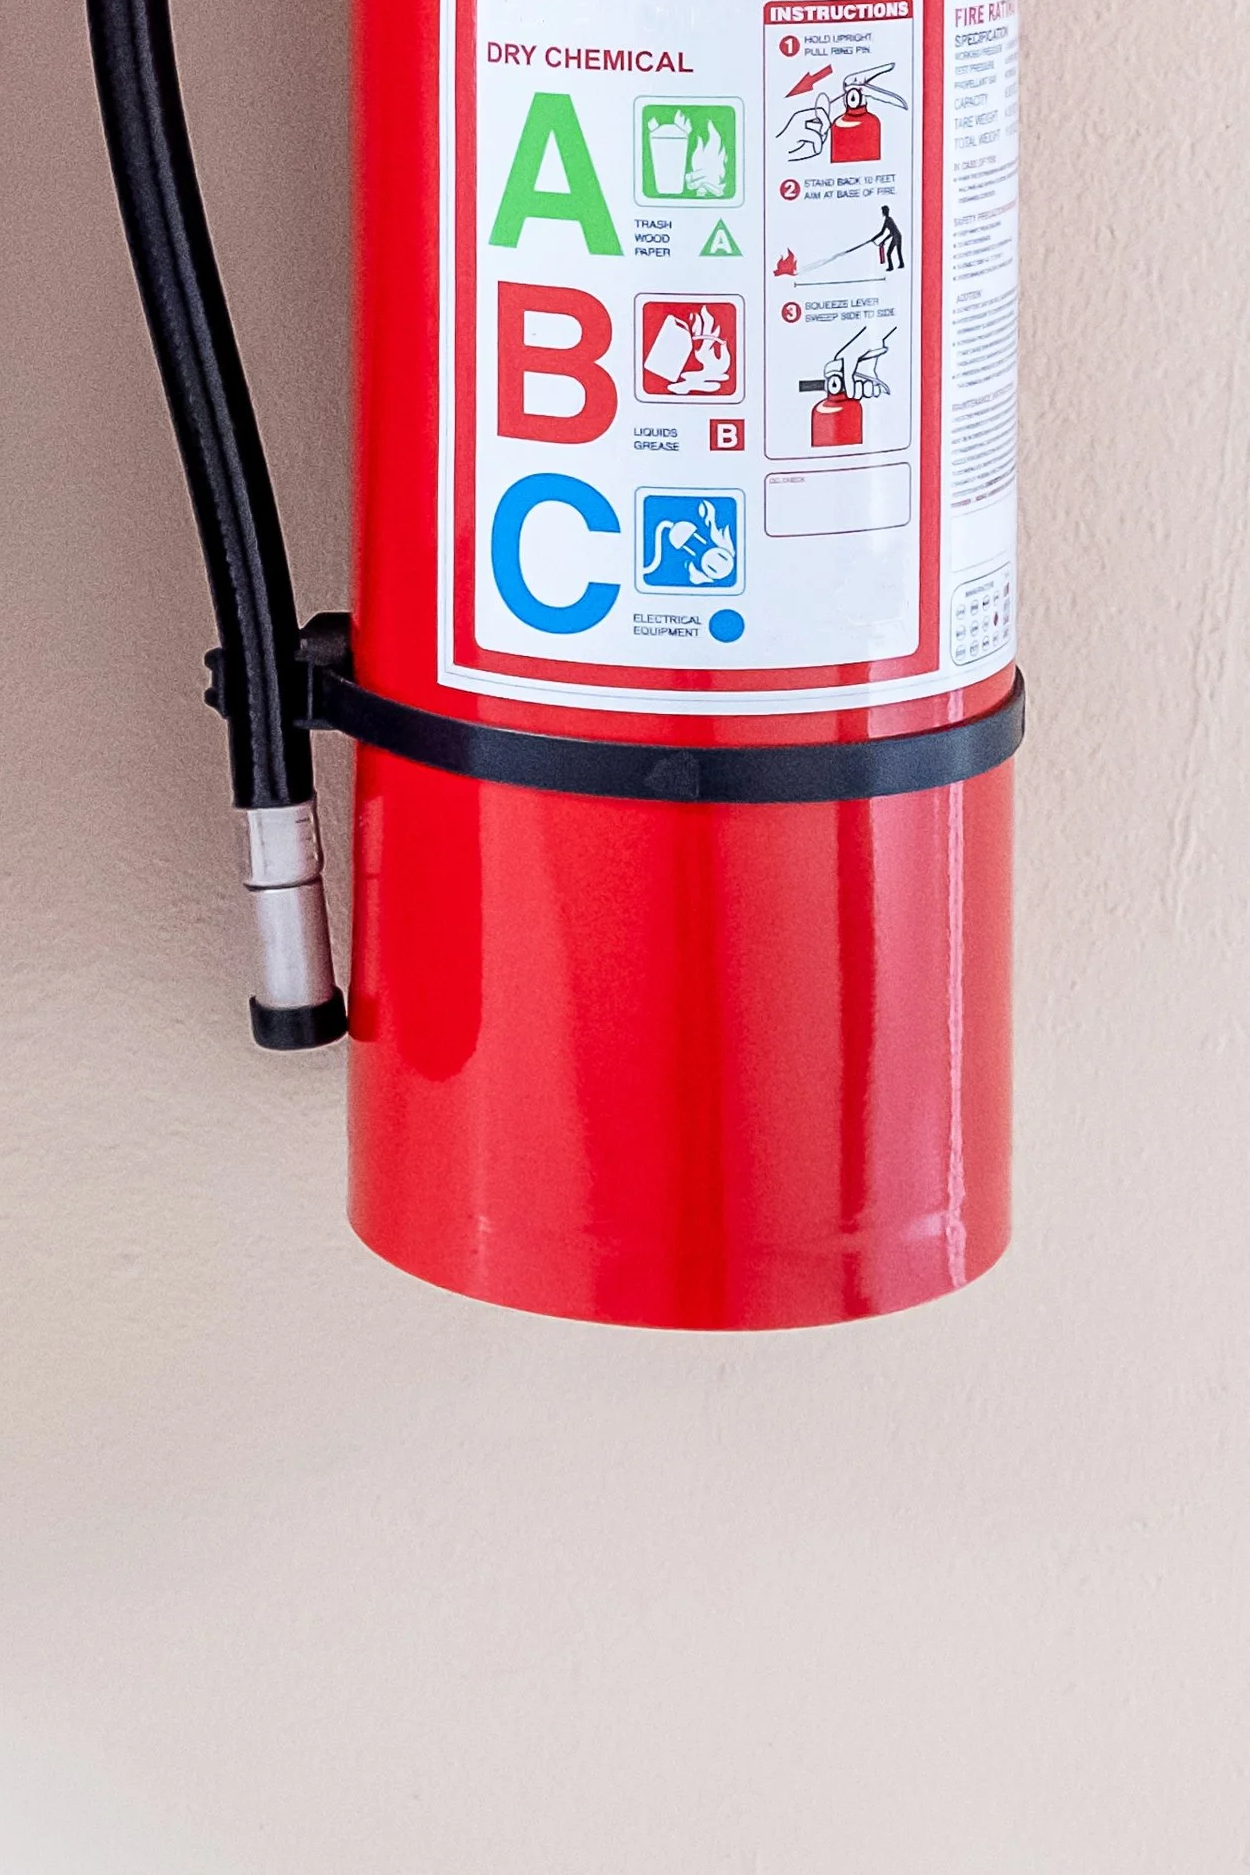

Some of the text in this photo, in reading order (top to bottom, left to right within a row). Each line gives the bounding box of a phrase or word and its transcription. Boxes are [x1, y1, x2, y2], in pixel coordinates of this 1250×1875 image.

[770, 1, 908, 22] INSTRUCTIONS
[955, 4, 985, 28] FIRE
[804, 34, 831, 44] HOLD
[487, 41, 694, 73] DRY CHEMICAL
[804, 47, 828, 56] PULL
[831, 47, 853, 56] RING
[488, 92, 624, 256] A
[804, 178, 835, 188] STAND
[837, 176, 861, 186] BACK
[864, 175, 874, 184] 10
[875, 173, 896, 183] FEET
[804, 191, 821, 200] AIM
[824, 190, 833, 198] AT
[837, 189, 860, 199] BASE
[862, 188, 874, 197] OF
[634, 219, 672, 229] TRASH
[634, 233, 670, 244] WOOD
[709, 229, 733, 254] A
[634, 247, 671, 257] PAPER
[805, 299, 849, 310] SQUEEZE
[851, 297, 879, 307] LEVER
[805, 312, 839, 322] SWEEP
[840, 310, 861, 320] SIDE
[863, 310, 874, 319] TO
[497, 280, 618, 444] B
[634, 427, 678, 438] LIQUIDS
[717, 423, 739, 449] B
[634, 441, 680, 451] GREASE
[491, 472, 621, 635] C
[633, 613, 702, 625] ELECTRICAL
[633, 626, 699, 637] EQUIPMENT
